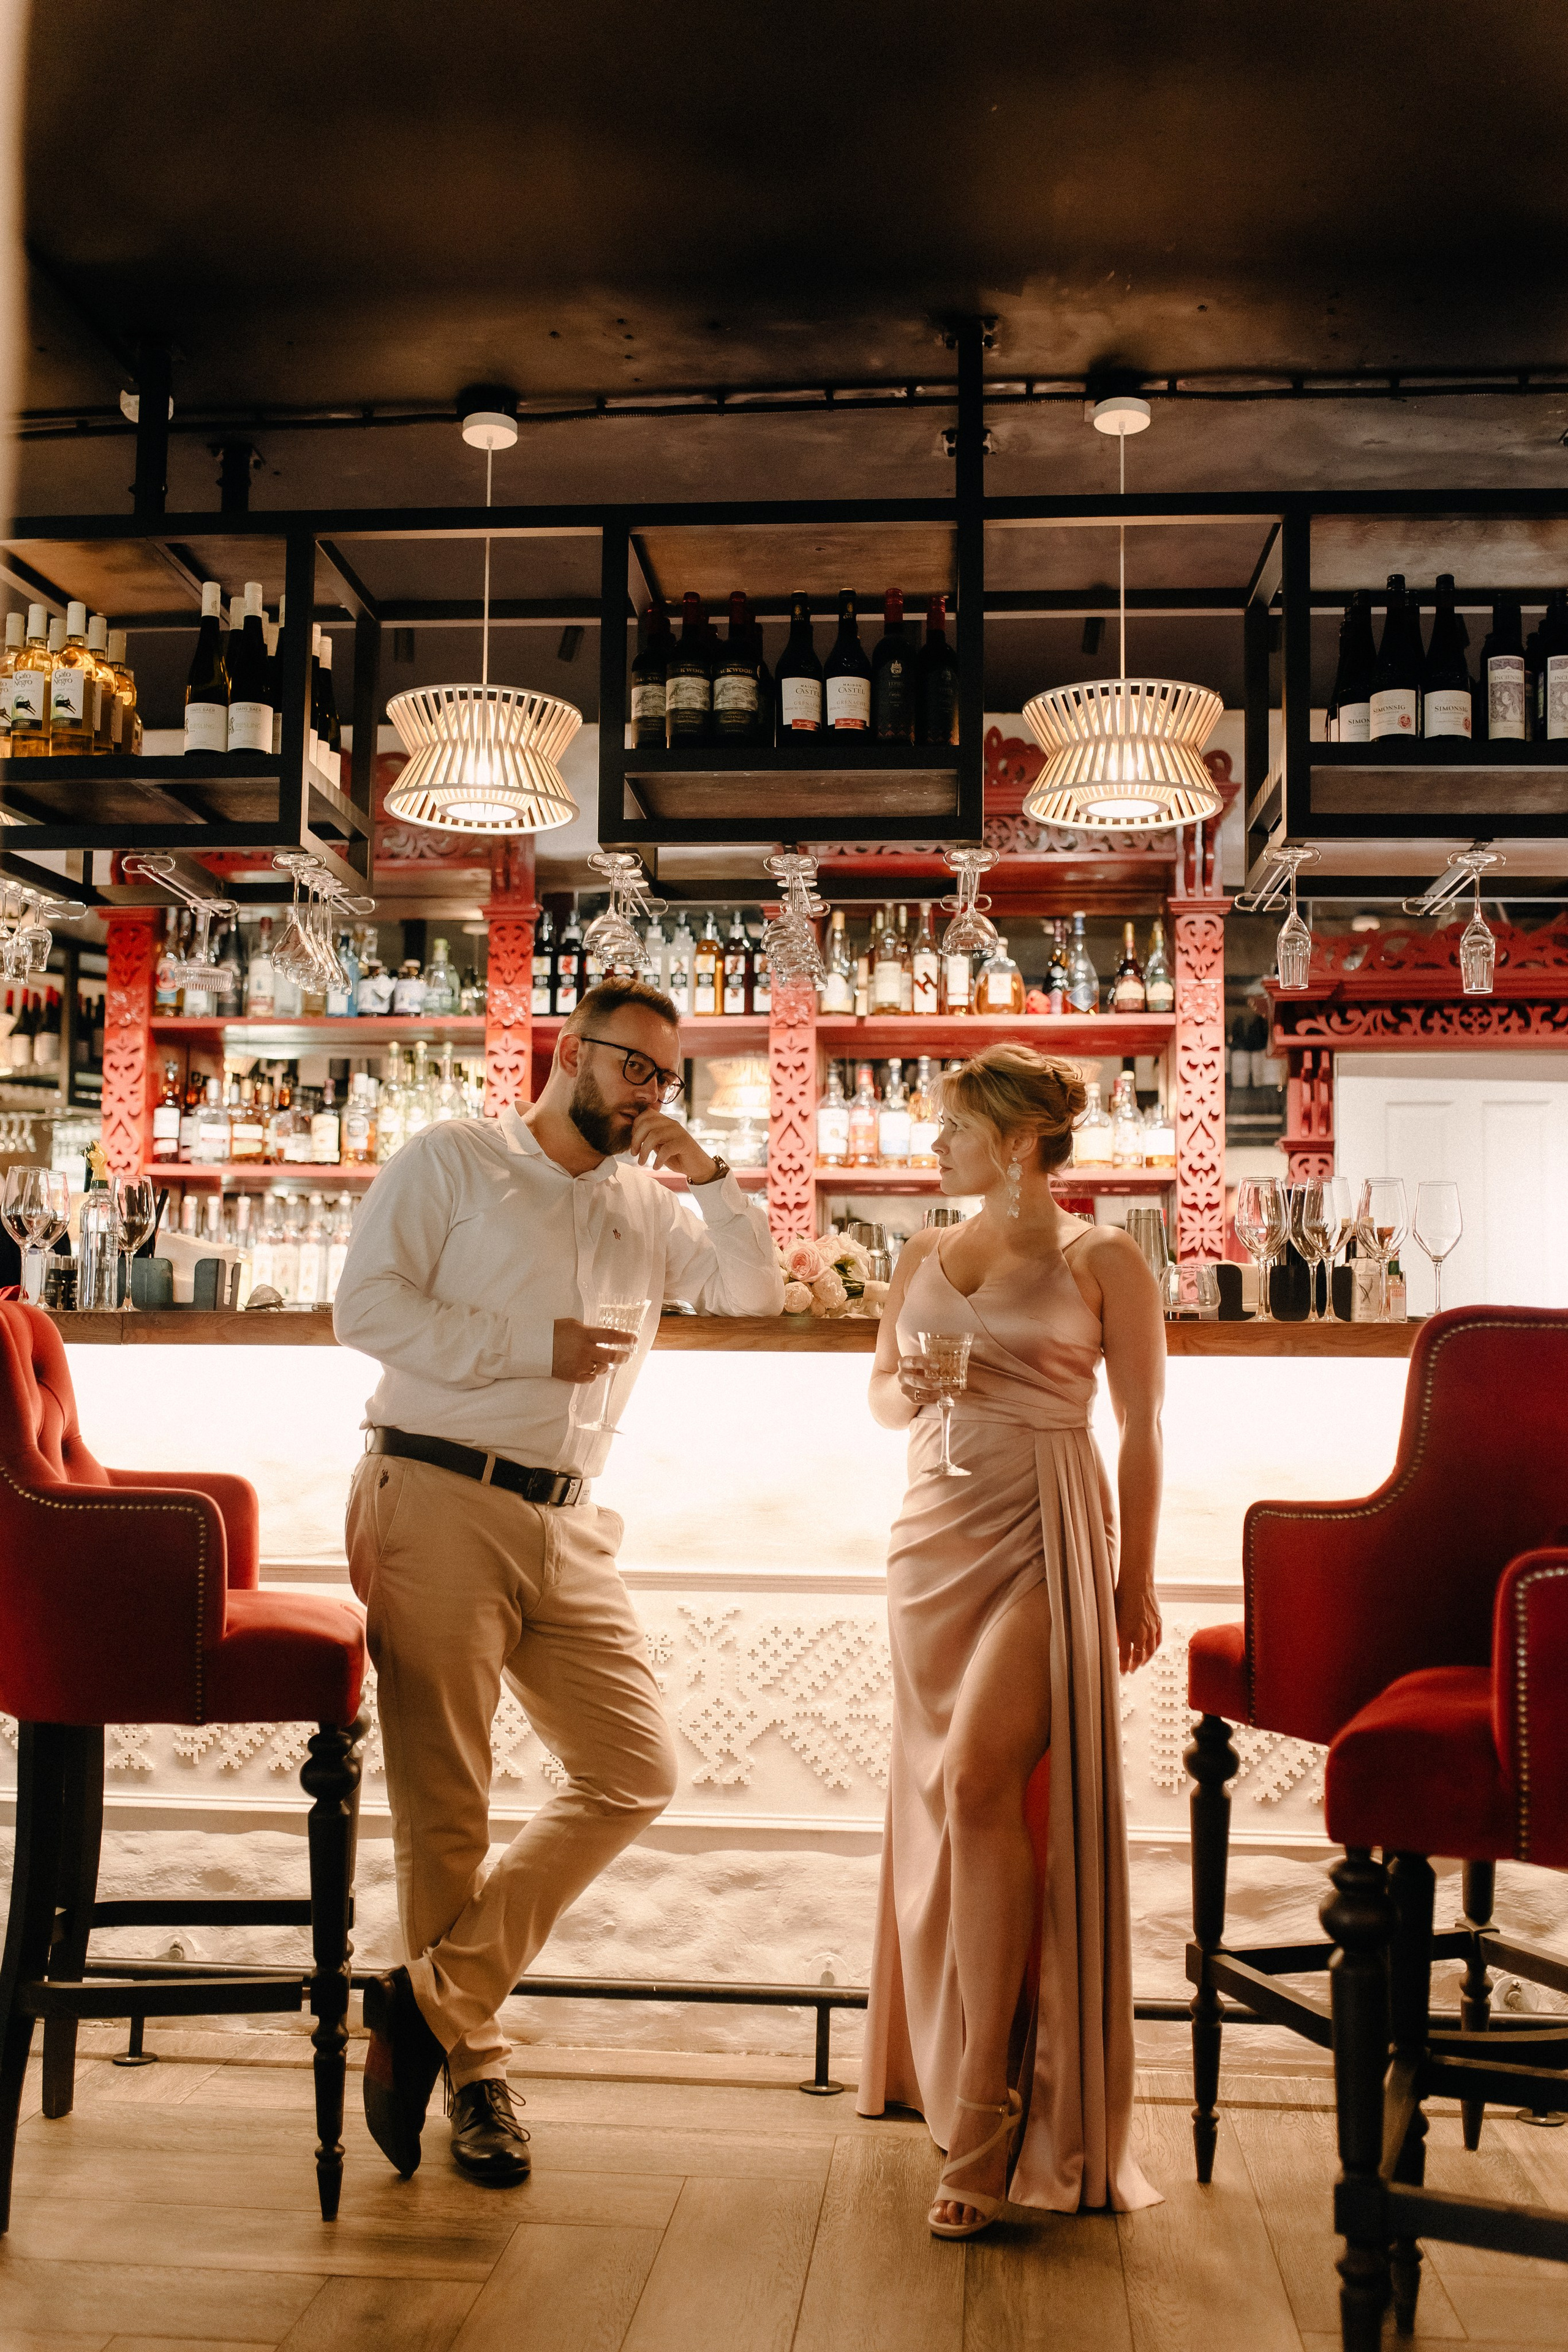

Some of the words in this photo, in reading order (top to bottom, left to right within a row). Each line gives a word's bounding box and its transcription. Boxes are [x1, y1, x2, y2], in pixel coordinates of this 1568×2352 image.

[15, 672, 31, 680] Gato
[55, 670, 72, 680] Gato
[14, 679, 33, 688] Negro
[53, 677, 73, 686] Negro
[796, 688, 821, 698] CASTEL
[1373, 704, 1406, 714] SIMONSIG
